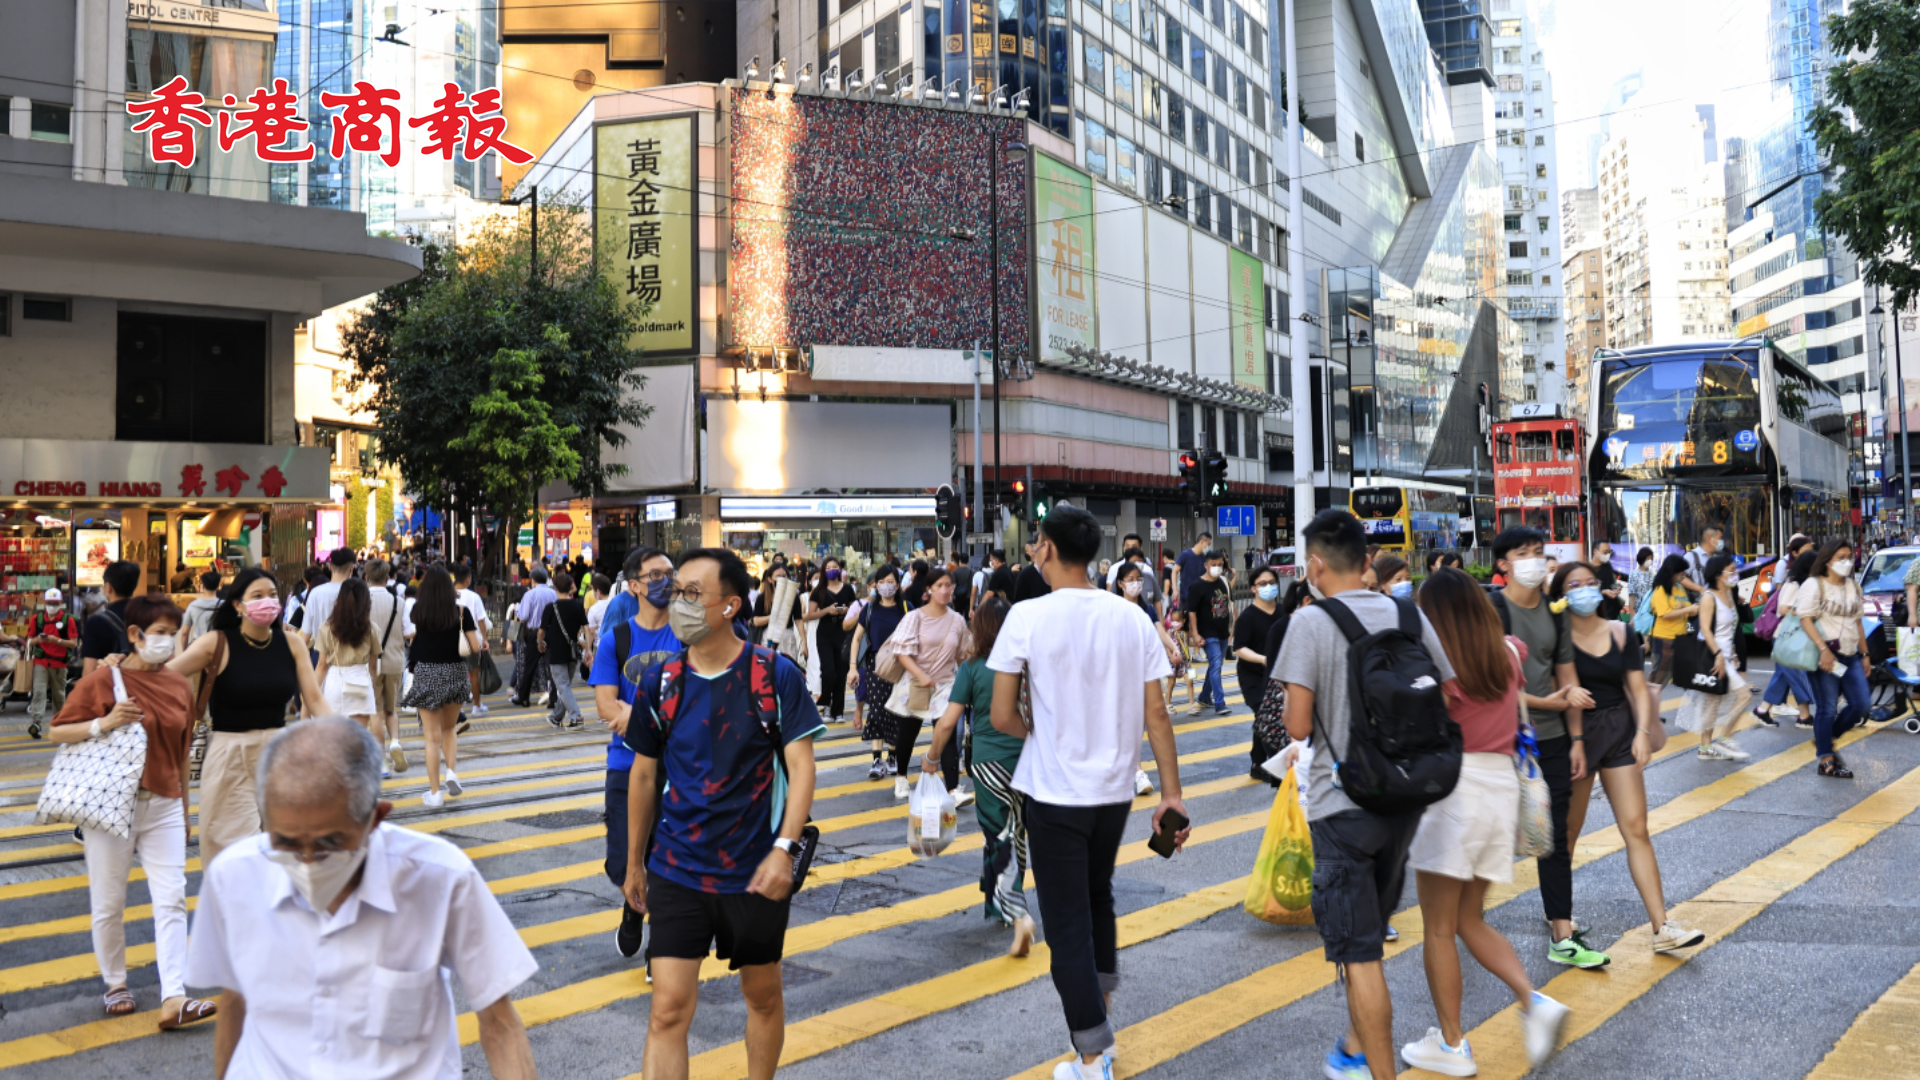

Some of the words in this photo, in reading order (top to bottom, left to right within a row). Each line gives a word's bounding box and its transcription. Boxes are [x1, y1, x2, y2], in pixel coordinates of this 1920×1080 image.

[170, 7, 219, 22] CENTRE
[626, 138, 662, 302] 黃金廣場
[1051, 219, 1085, 300] 租
[1047, 305, 1064, 324] FOR
[1065, 310, 1088, 331] LEASE
[629, 320, 685, 333] Goldmark
[1522, 404, 1541, 415] 67
[1495, 425, 1504, 433] 67
[1564, 422, 1574, 430] 67
[1712, 440, 1728, 464] 8
[14, 480, 87, 497] CHENG
[99, 482, 161, 497] HIANG
[839, 504, 863, 513] Good
[1275, 874, 1312, 896] SALE
